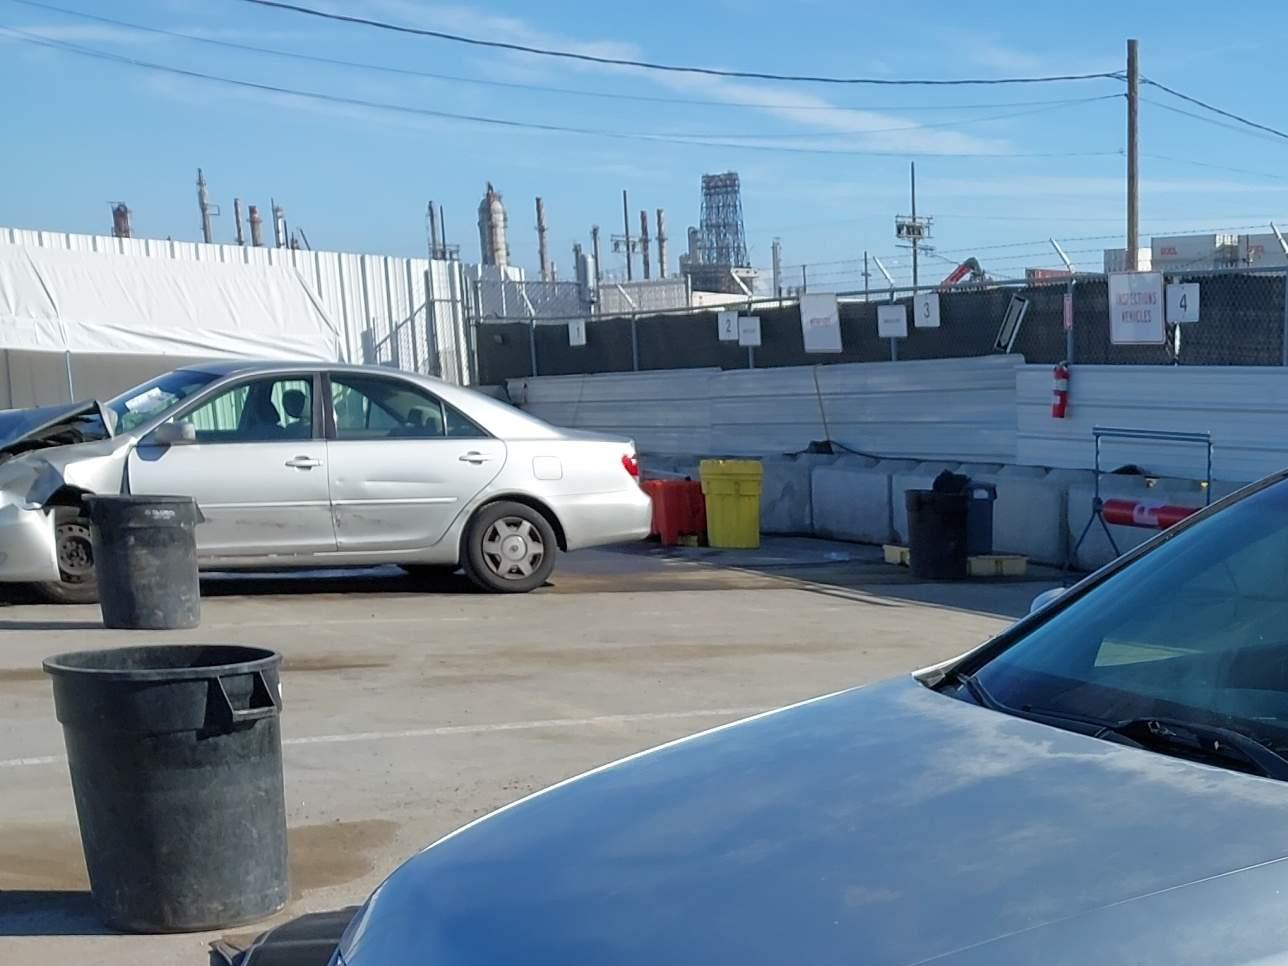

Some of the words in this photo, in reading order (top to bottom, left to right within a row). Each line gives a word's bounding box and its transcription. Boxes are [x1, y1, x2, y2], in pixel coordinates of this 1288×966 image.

[923, 302, 930, 319] 3
[1179, 293, 1188, 313] 4
[726, 319, 732, 333] 2
